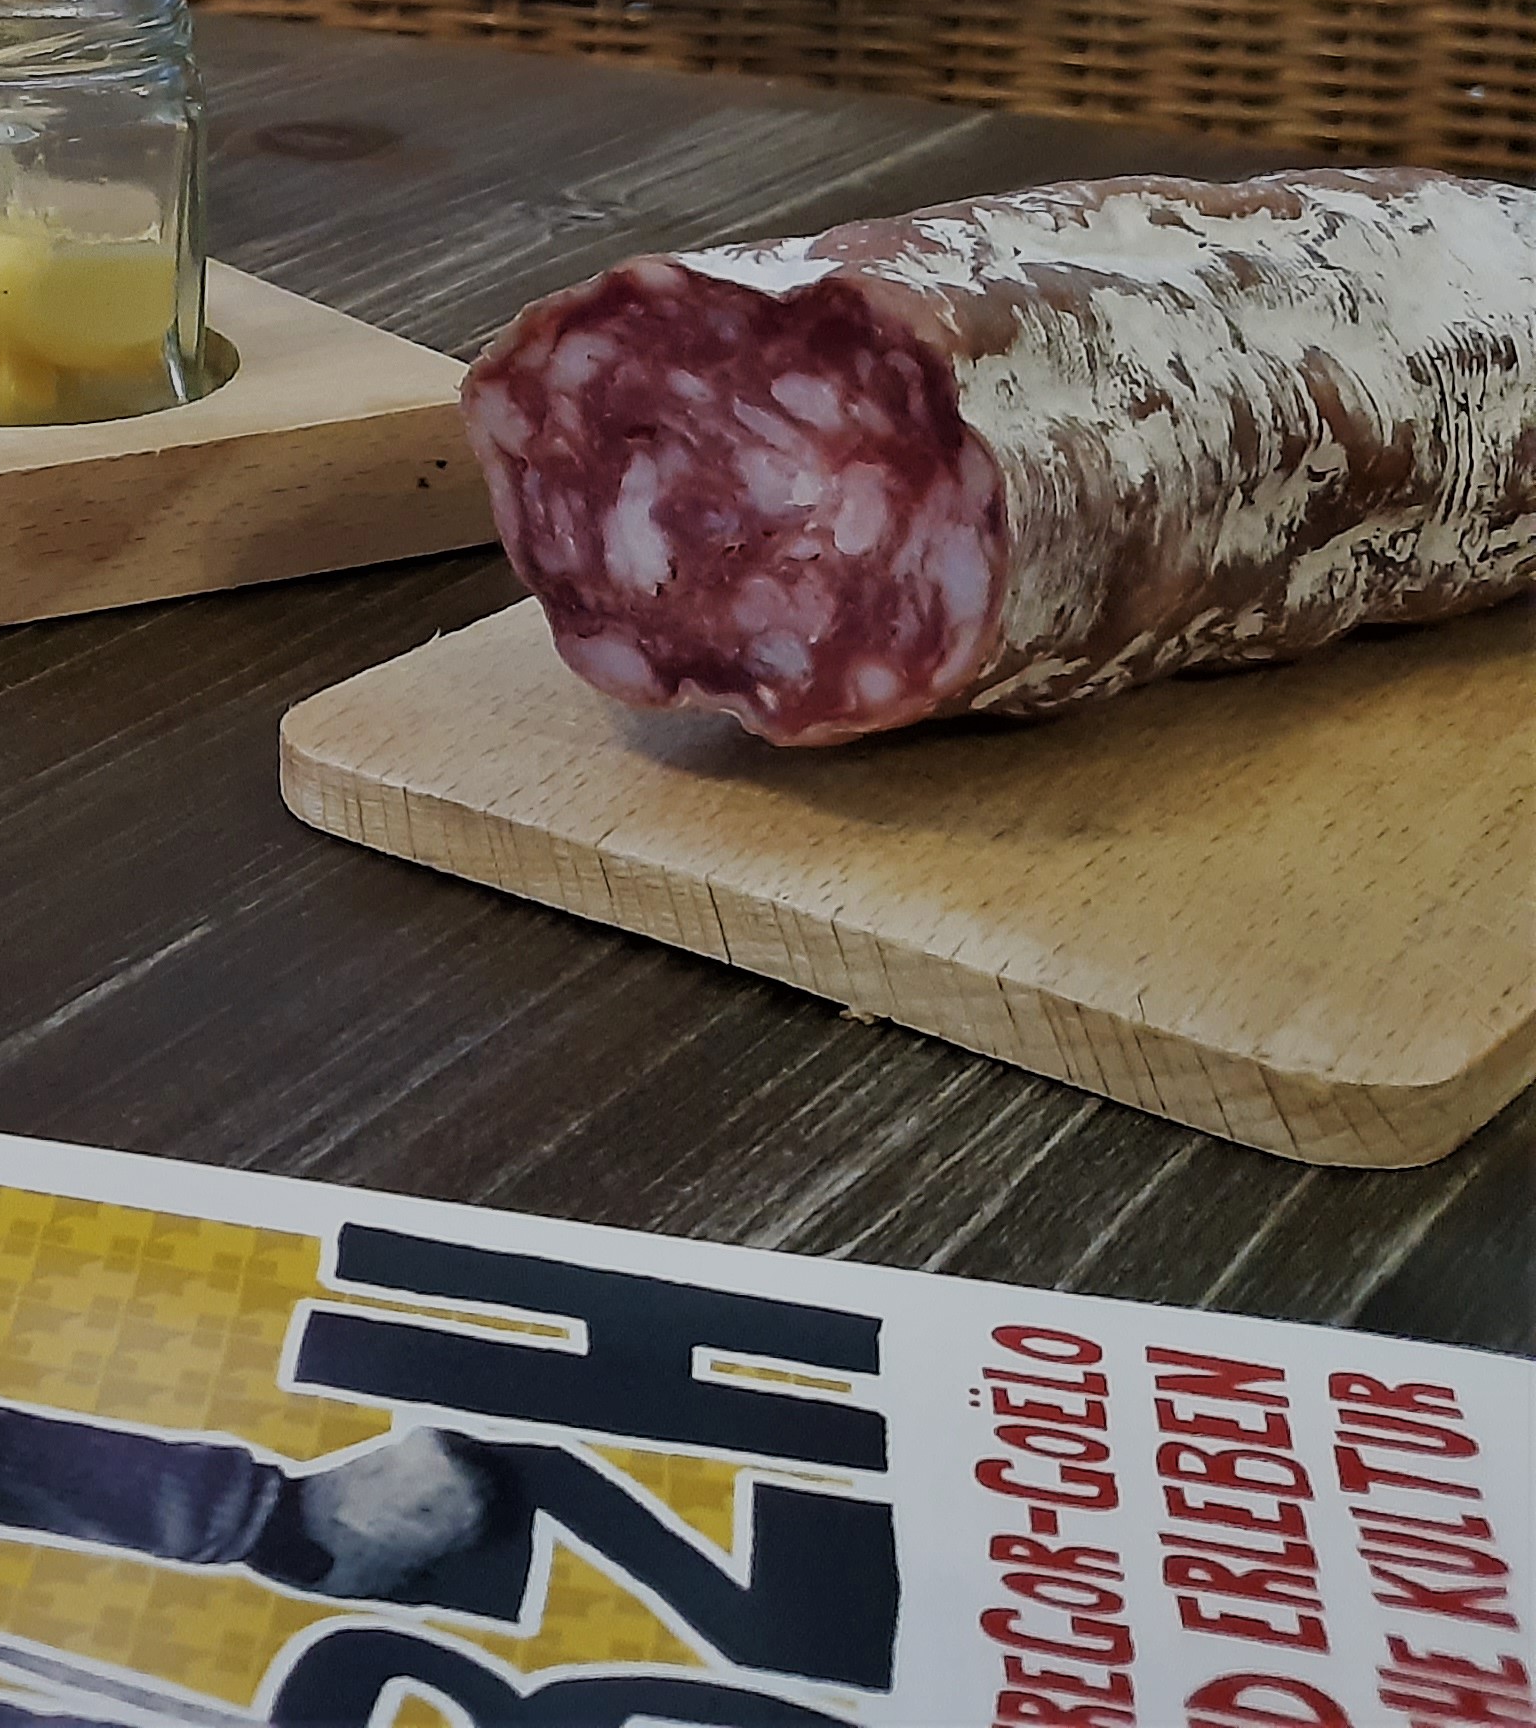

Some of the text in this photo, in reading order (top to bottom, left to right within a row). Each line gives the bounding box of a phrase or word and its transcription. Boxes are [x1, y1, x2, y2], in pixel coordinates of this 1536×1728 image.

[1144, 1344, 1332, 1657] ERLEBEN
[1327, 1371, 1534, 1728] HE KULTUR
